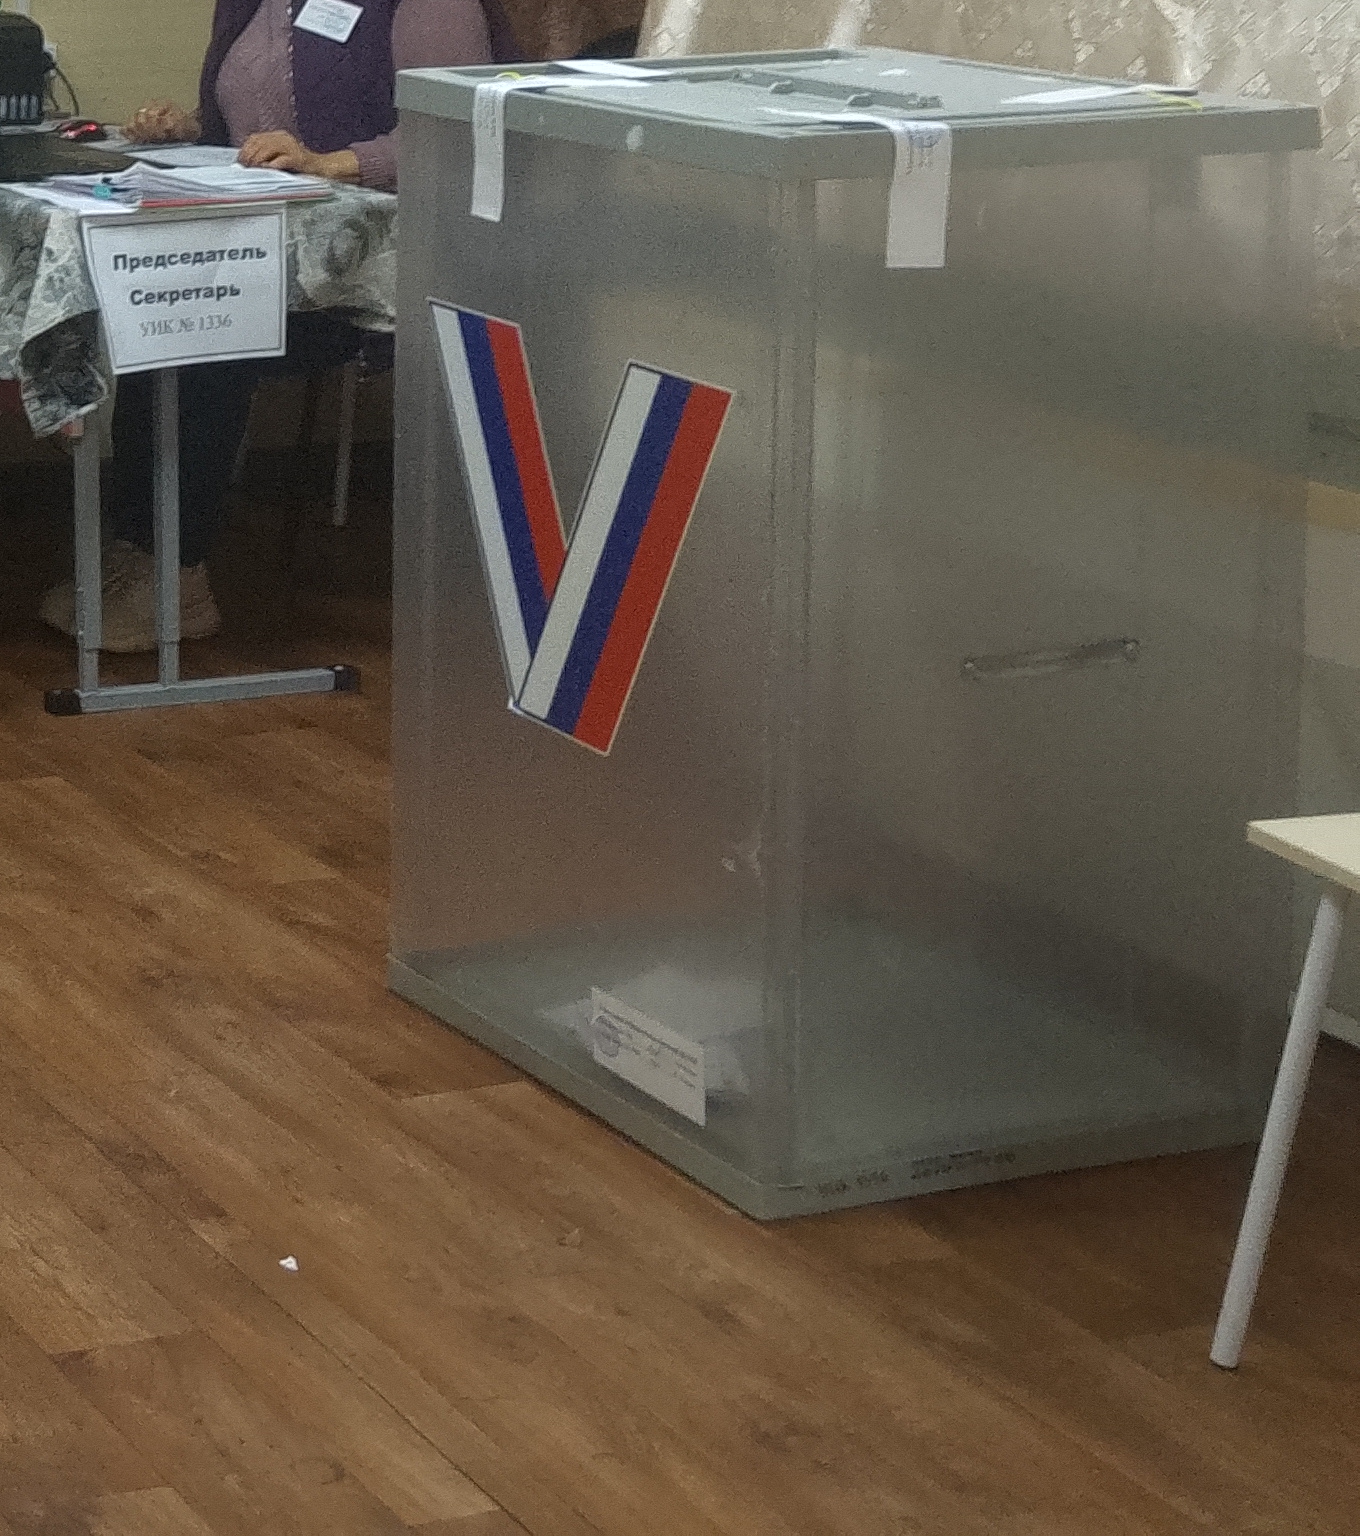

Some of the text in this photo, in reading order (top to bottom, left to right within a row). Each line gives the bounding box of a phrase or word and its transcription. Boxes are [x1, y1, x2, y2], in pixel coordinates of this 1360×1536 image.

[113, 246, 267, 273] Председатель
[130, 283, 241, 306] Секретарь
[140, 320, 173, 337] УИК
[199, 314, 232, 331] 1336
